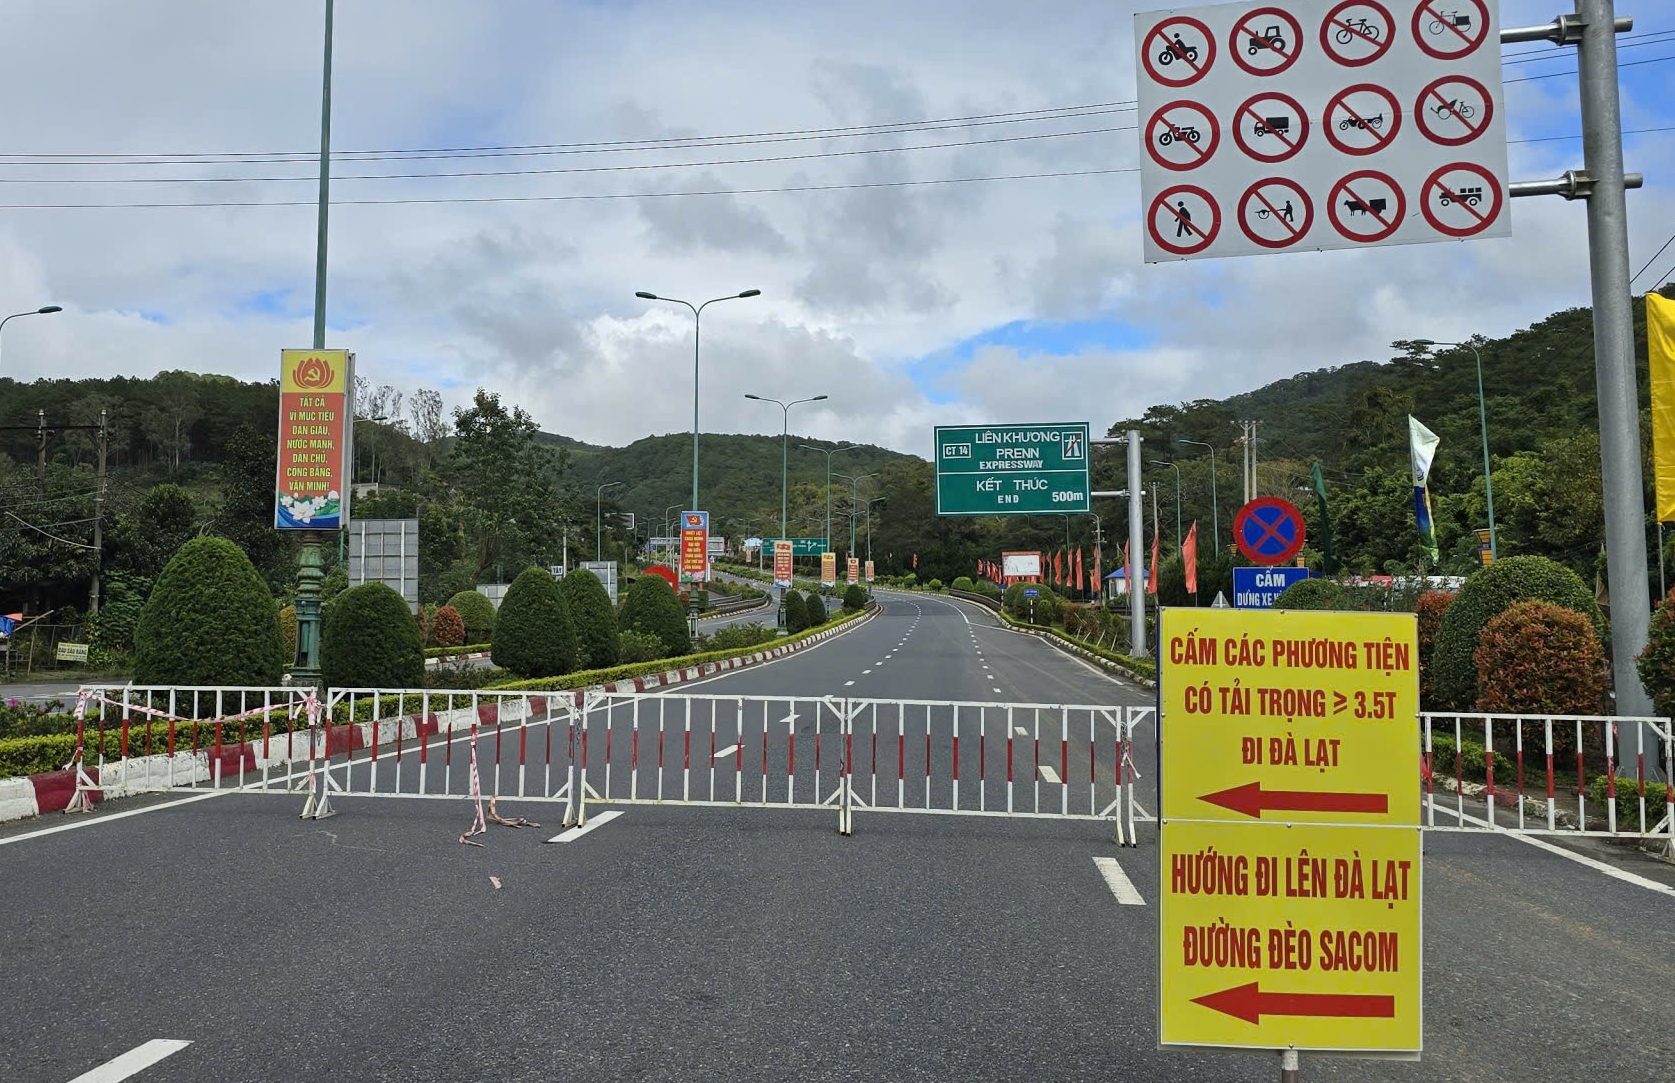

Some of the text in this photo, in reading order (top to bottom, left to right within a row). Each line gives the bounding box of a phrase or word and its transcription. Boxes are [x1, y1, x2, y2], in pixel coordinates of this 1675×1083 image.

[300, 395, 324, 407] TẤT CẢ
[299, 411, 316, 422] MỤC
[318, 410, 334, 421] TIÊU
[976, 430, 1060, 444] LIÊN KHƯƠNG
[287, 438, 334, 450] NƯỚC MẠNH,
[946, 446, 968, 456] CT 14
[996, 448, 1039, 459] PRENN
[287, 466, 308, 476] CÔNG
[980, 460, 1043, 470] EXPRESSWAY
[306, 482, 330, 490] MINH!
[976, 477, 1048, 492] KẾT THÚC
[998, 495, 1019, 504] END
[1052, 492, 1084, 502] 500m
[1256, 566, 1286, 587] CẤM
[1238, 589, 1260, 606] DỪNG
[1262, 592, 1272, 606] XE
[1170, 628, 1410, 676] CẤM CÁC PHƯƠNG TIỆN
[1184, 681, 1212, 714] CÓ
[1219, 678, 1250, 715] TẢI
[1258, 688, 1326, 722] TRỌNG
[1354, 691, 1396, 719] 3.5T
[1242, 732, 1340, 773] ĐI ĐÀ LẠT
[1172, 846, 1410, 909] HƯỚNG ĐI LÊN ĐÀ LẠT
[1183, 916, 1398, 972] ĐƯỜNG ĐÈO SACOM
